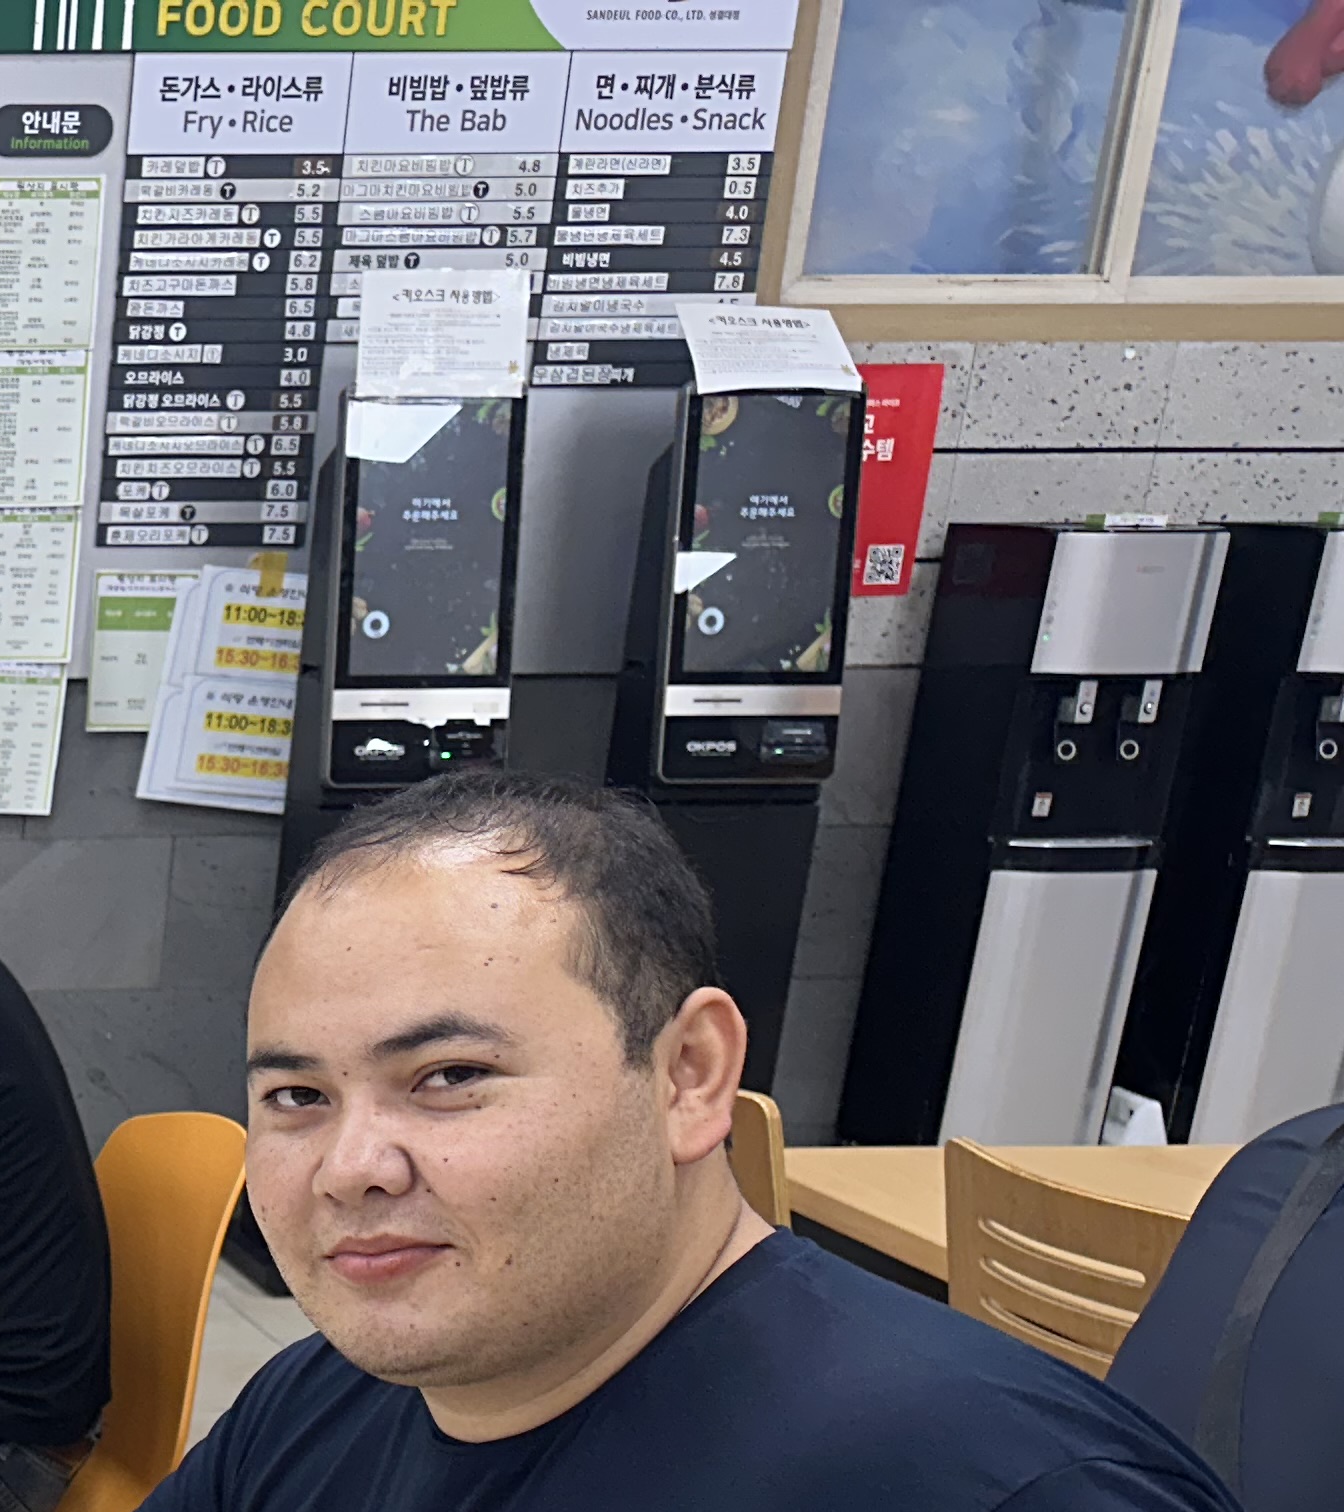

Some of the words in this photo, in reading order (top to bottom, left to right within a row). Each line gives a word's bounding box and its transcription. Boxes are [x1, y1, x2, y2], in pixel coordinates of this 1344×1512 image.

[157, 0, 282, 36] FOOD
[300, 0, 458, 36] COURT
[586, 10, 631, 20] SANDEUL
[635, 10, 662, 20] FOOD
[160, 76, 221, 101] 돈가스
[241, 75, 323, 101] 라이스류
[388, 74, 450, 101] 비빔밥
[470, 74, 530, 101] 덮밥류
[596, 74, 615, 100] 면
[634, 74, 674, 101] 찌개
[694, 73, 756, 100] 분식류
[21, 111, 81, 136] 안내문
[183, 110, 223, 138] Fry
[242, 109, 293, 133] Rice
[406, 109, 450, 132] The
[460, 109, 507, 132] Bab
[575, 108, 673, 132] Noodles
[692, 107, 767, 131] Snack
[10, 137, 90, 151] Information
